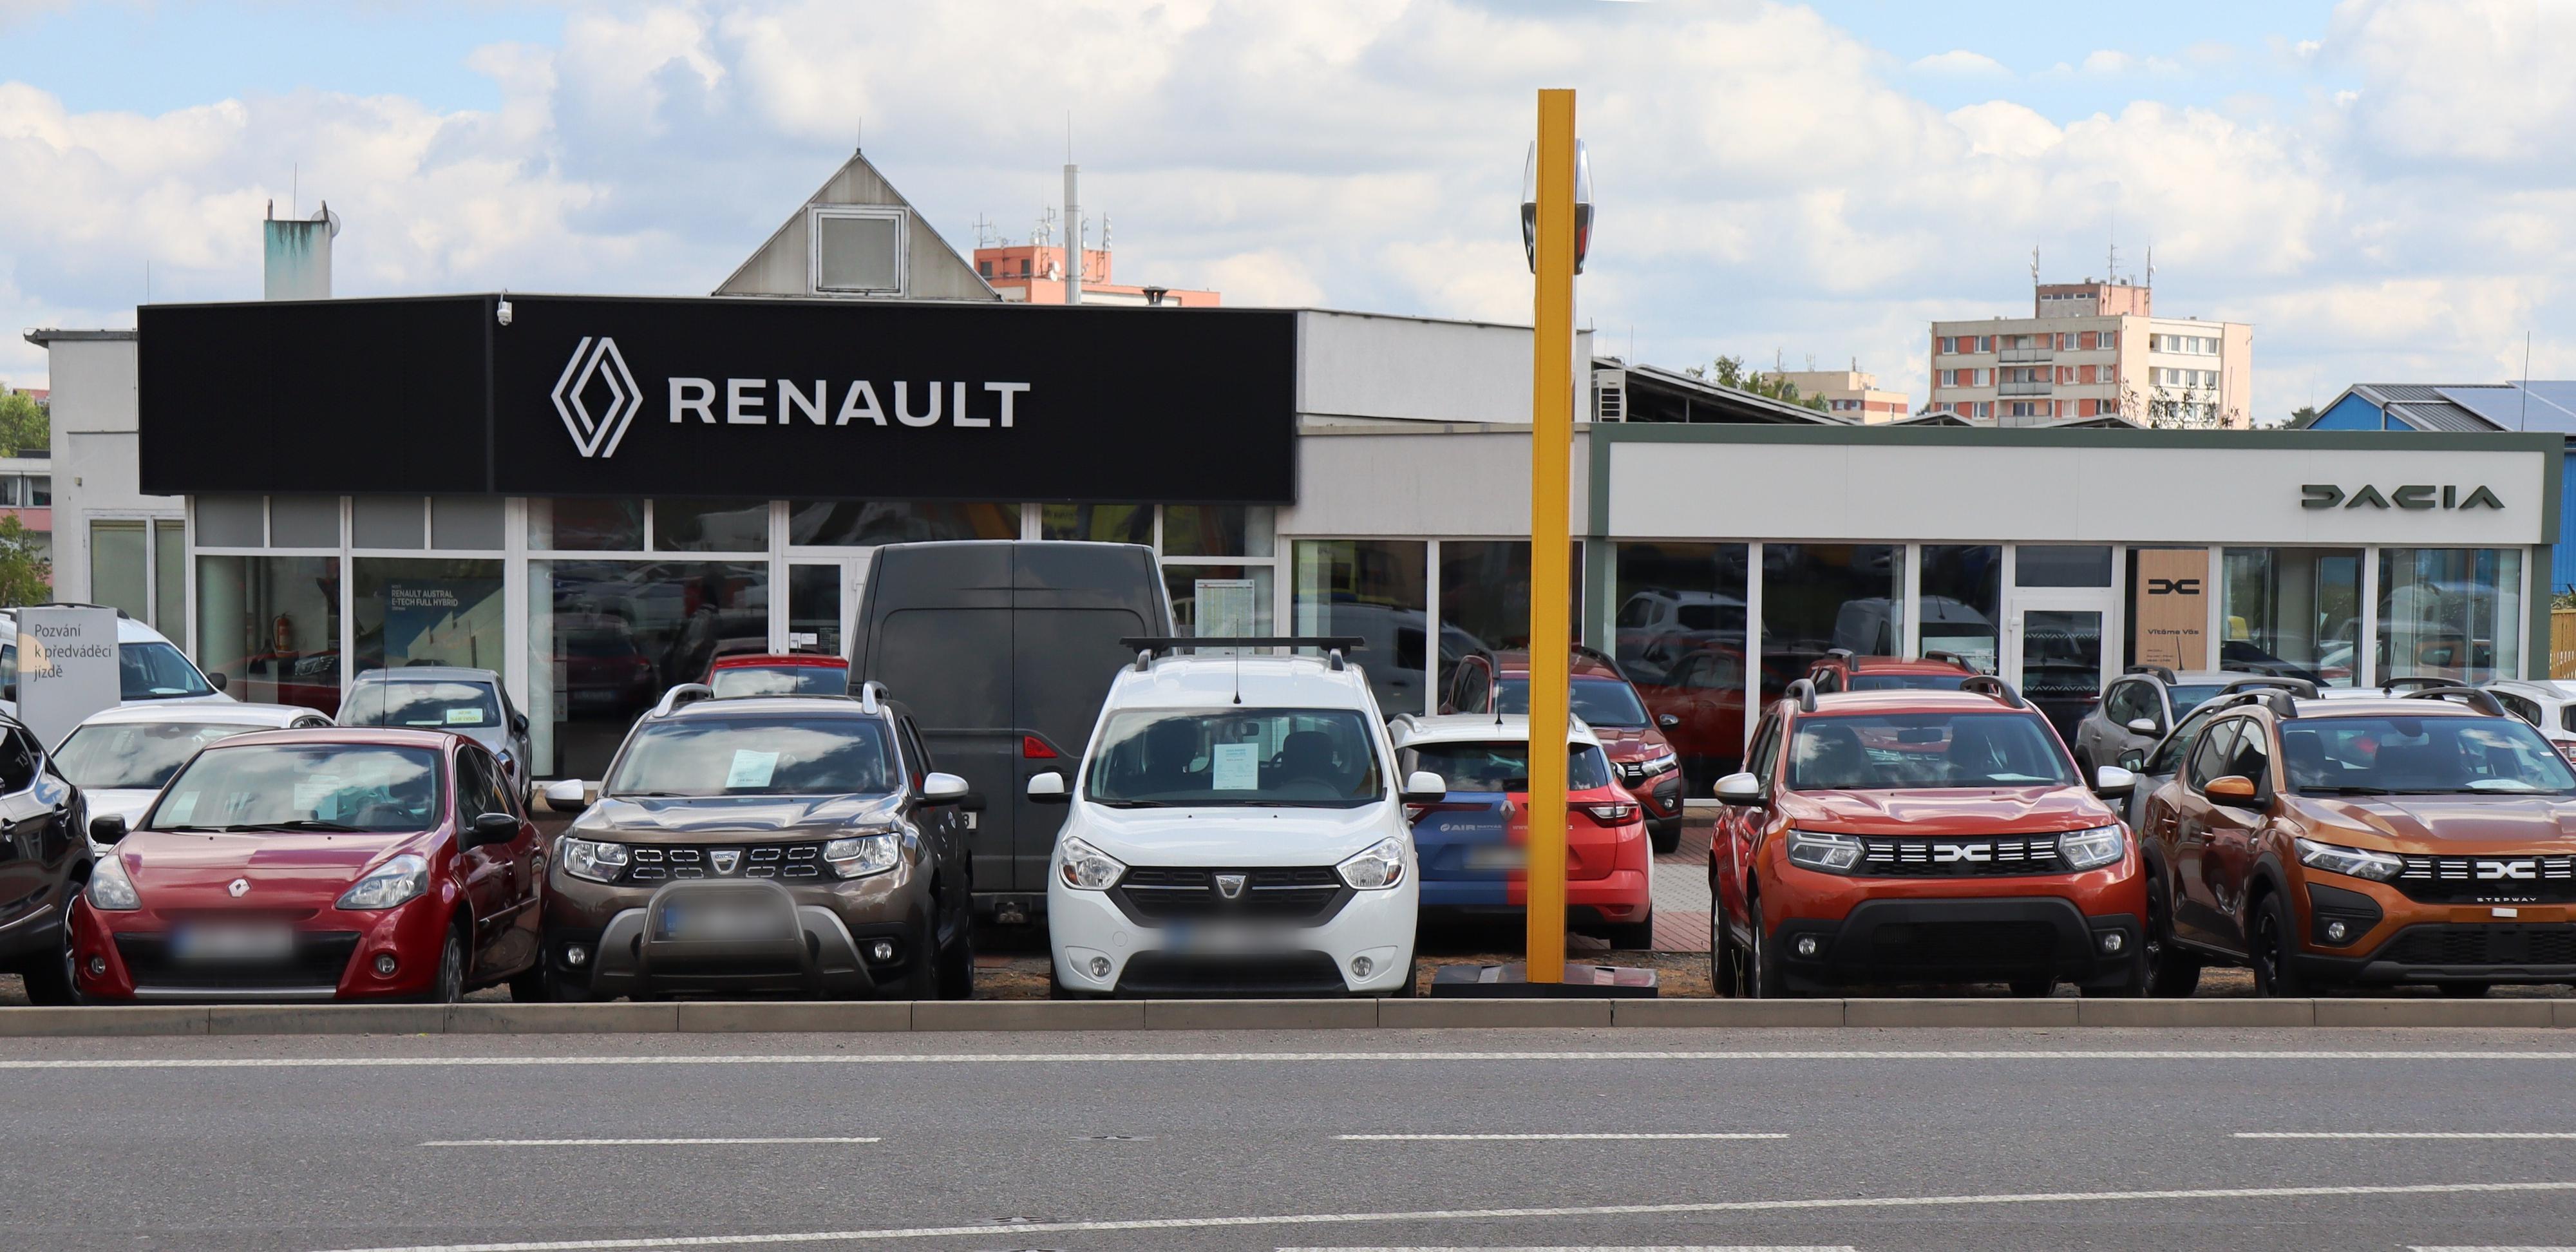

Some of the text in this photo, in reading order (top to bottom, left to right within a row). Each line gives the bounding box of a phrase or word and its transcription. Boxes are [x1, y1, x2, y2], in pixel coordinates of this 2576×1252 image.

[668, 377, 1030, 428] RENAULT
[2301, 484, 2506, 509] DACIA
[392, 589, 453, 598] RENAULT AUSTRAL
[433, 598, 458, 607] HYBRID
[35, 623, 81, 637] Pozvání
[35, 644, 111, 661] k předváděcí
[33, 664, 63, 682] jízdě
